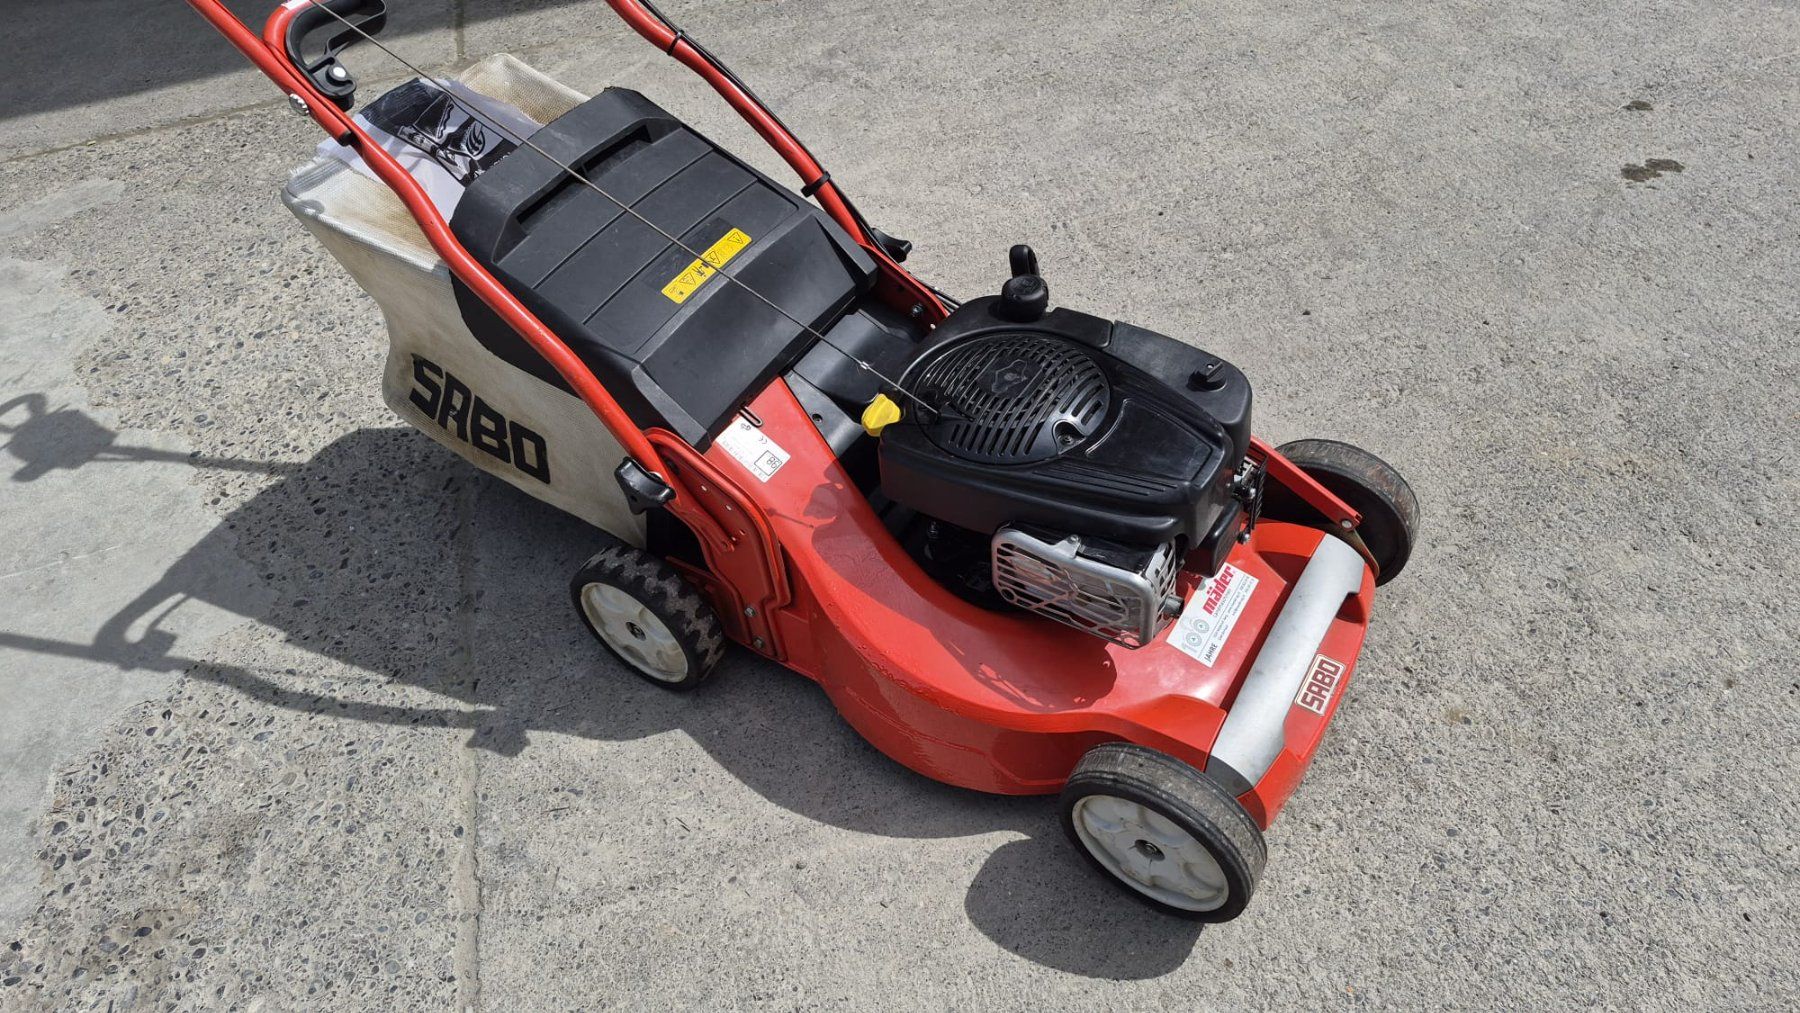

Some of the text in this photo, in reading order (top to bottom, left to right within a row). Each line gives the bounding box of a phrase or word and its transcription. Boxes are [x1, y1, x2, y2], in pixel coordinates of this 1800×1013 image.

[409, 353, 551, 485] SABO
[1202, 565, 1234, 616] mäder
[1204, 642, 1218, 663] JAHRE
[1300, 659, 1341, 711] SABO
